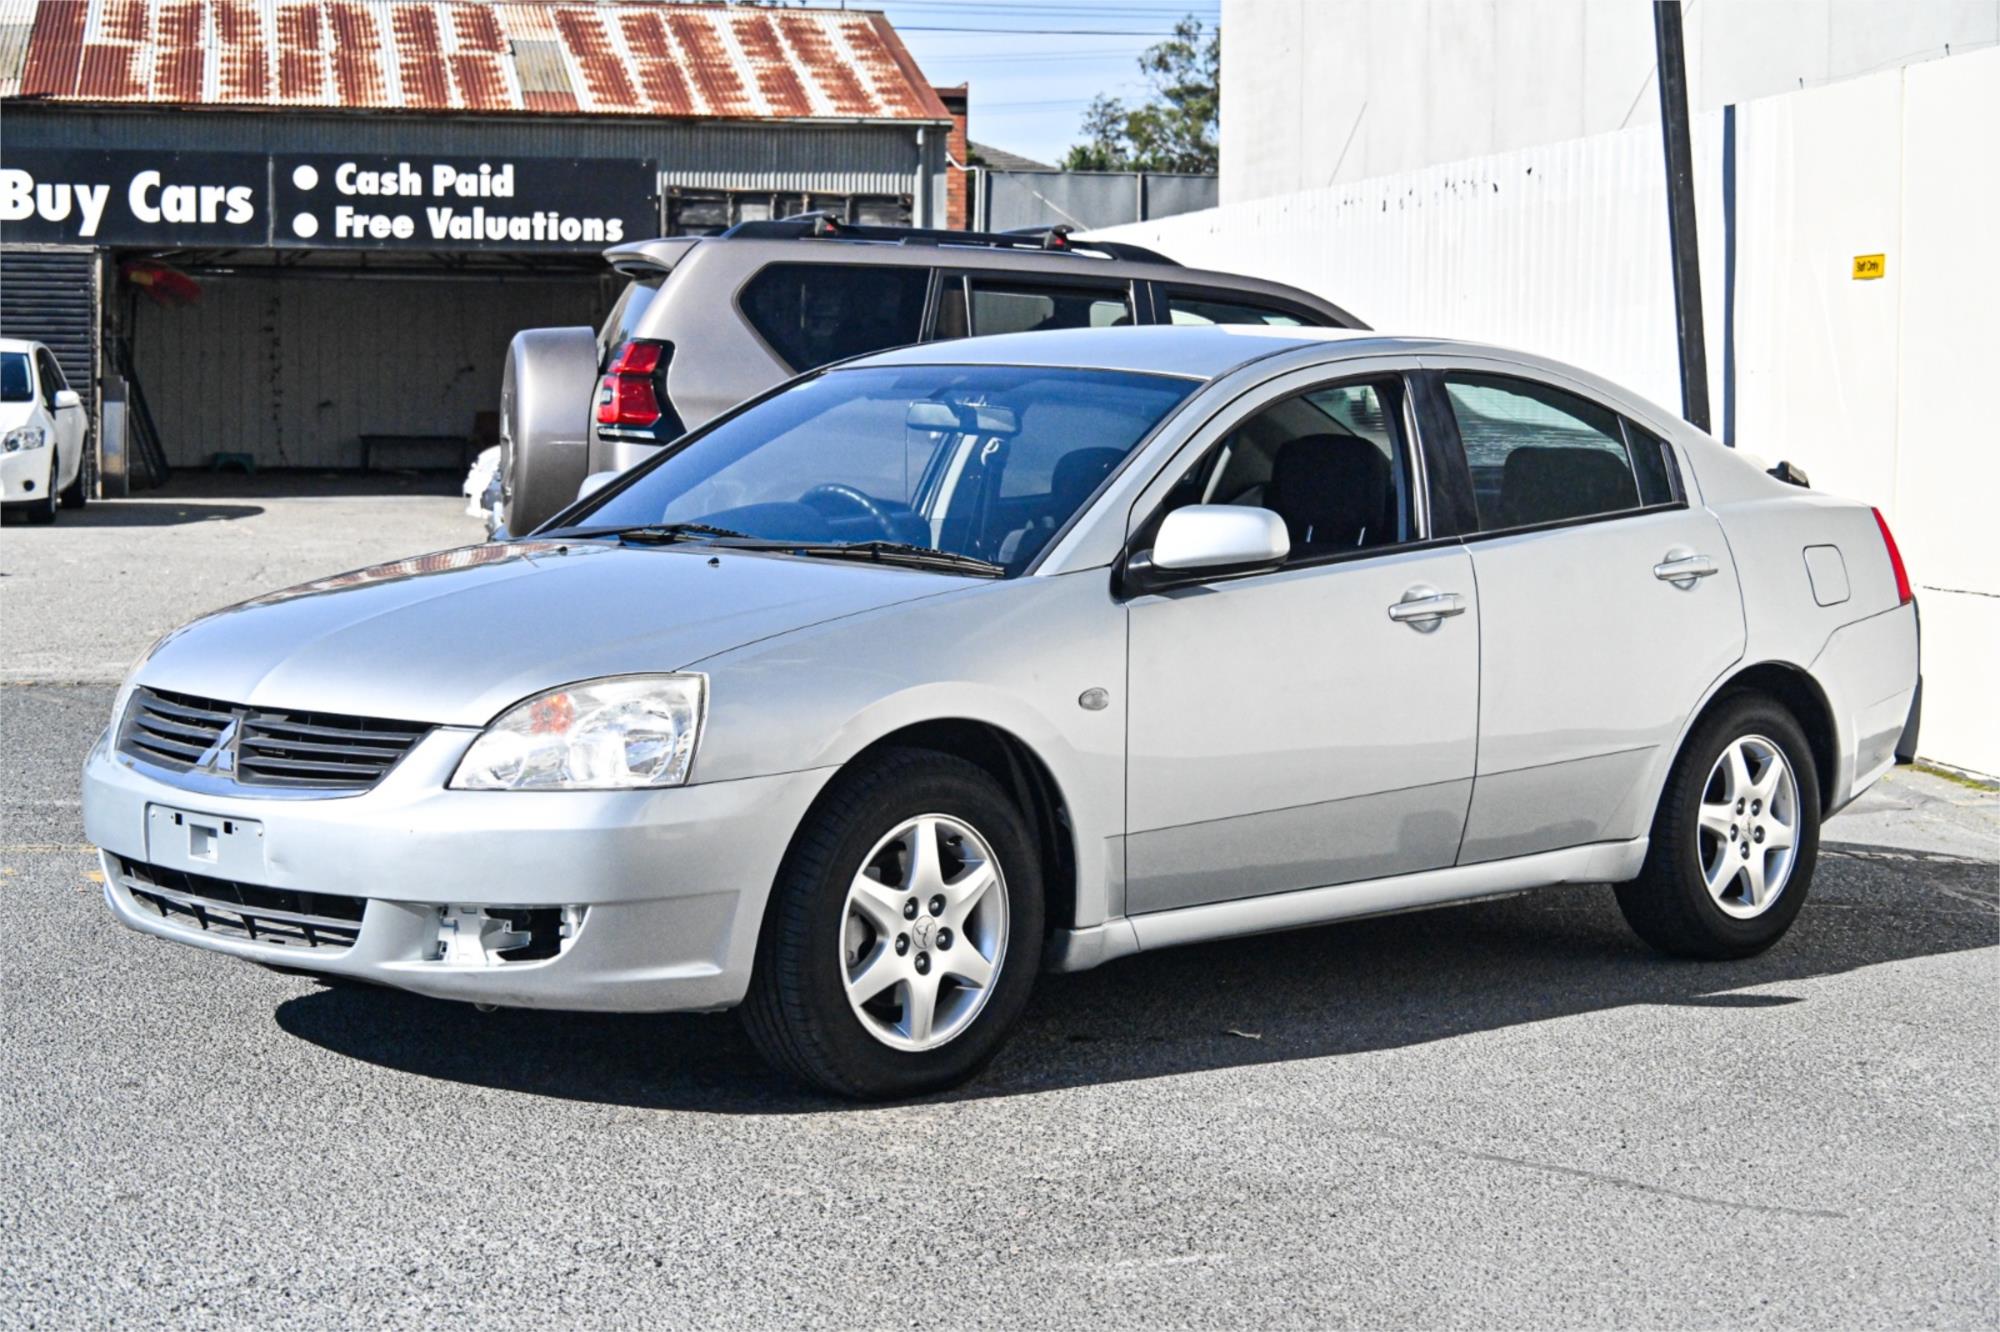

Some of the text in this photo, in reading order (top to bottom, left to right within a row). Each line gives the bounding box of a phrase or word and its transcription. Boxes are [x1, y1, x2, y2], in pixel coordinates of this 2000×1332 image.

[335, 161, 515, 198] Cash Paid
[0, 167, 254, 237] Buy Cars
[335, 205, 624, 243] Free Valuations
